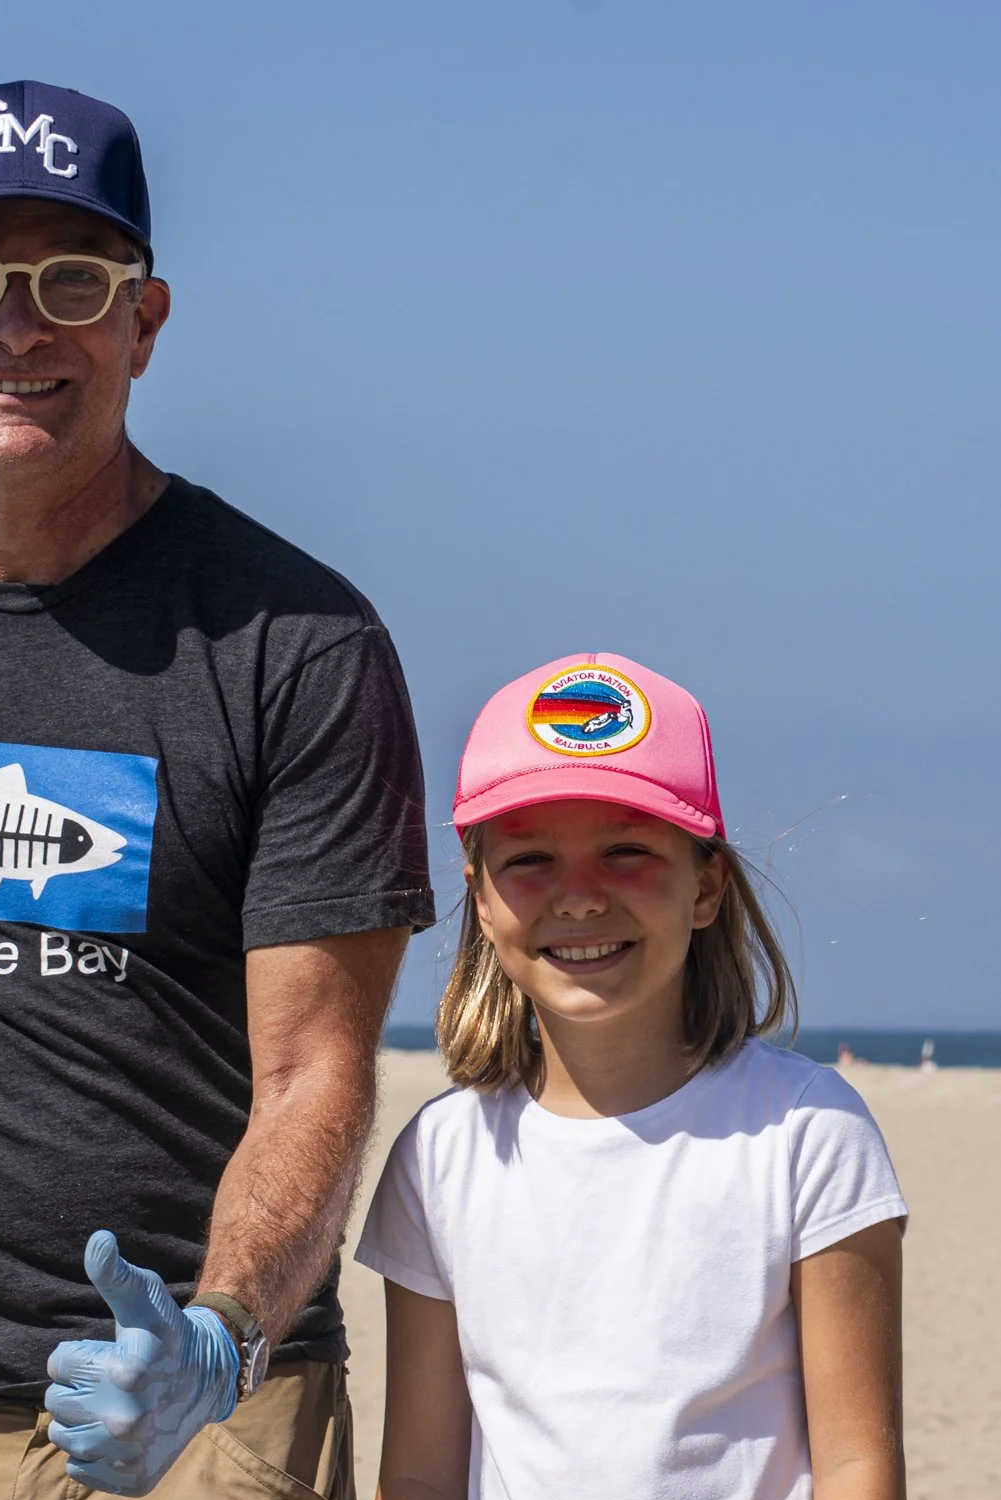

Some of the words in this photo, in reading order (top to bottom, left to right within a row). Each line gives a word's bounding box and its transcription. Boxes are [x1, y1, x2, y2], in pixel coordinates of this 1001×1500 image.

[551, 672, 595, 692] AVIATOR
[597, 673, 633, 697] NATION
[40, 930, 129, 983] Bay
